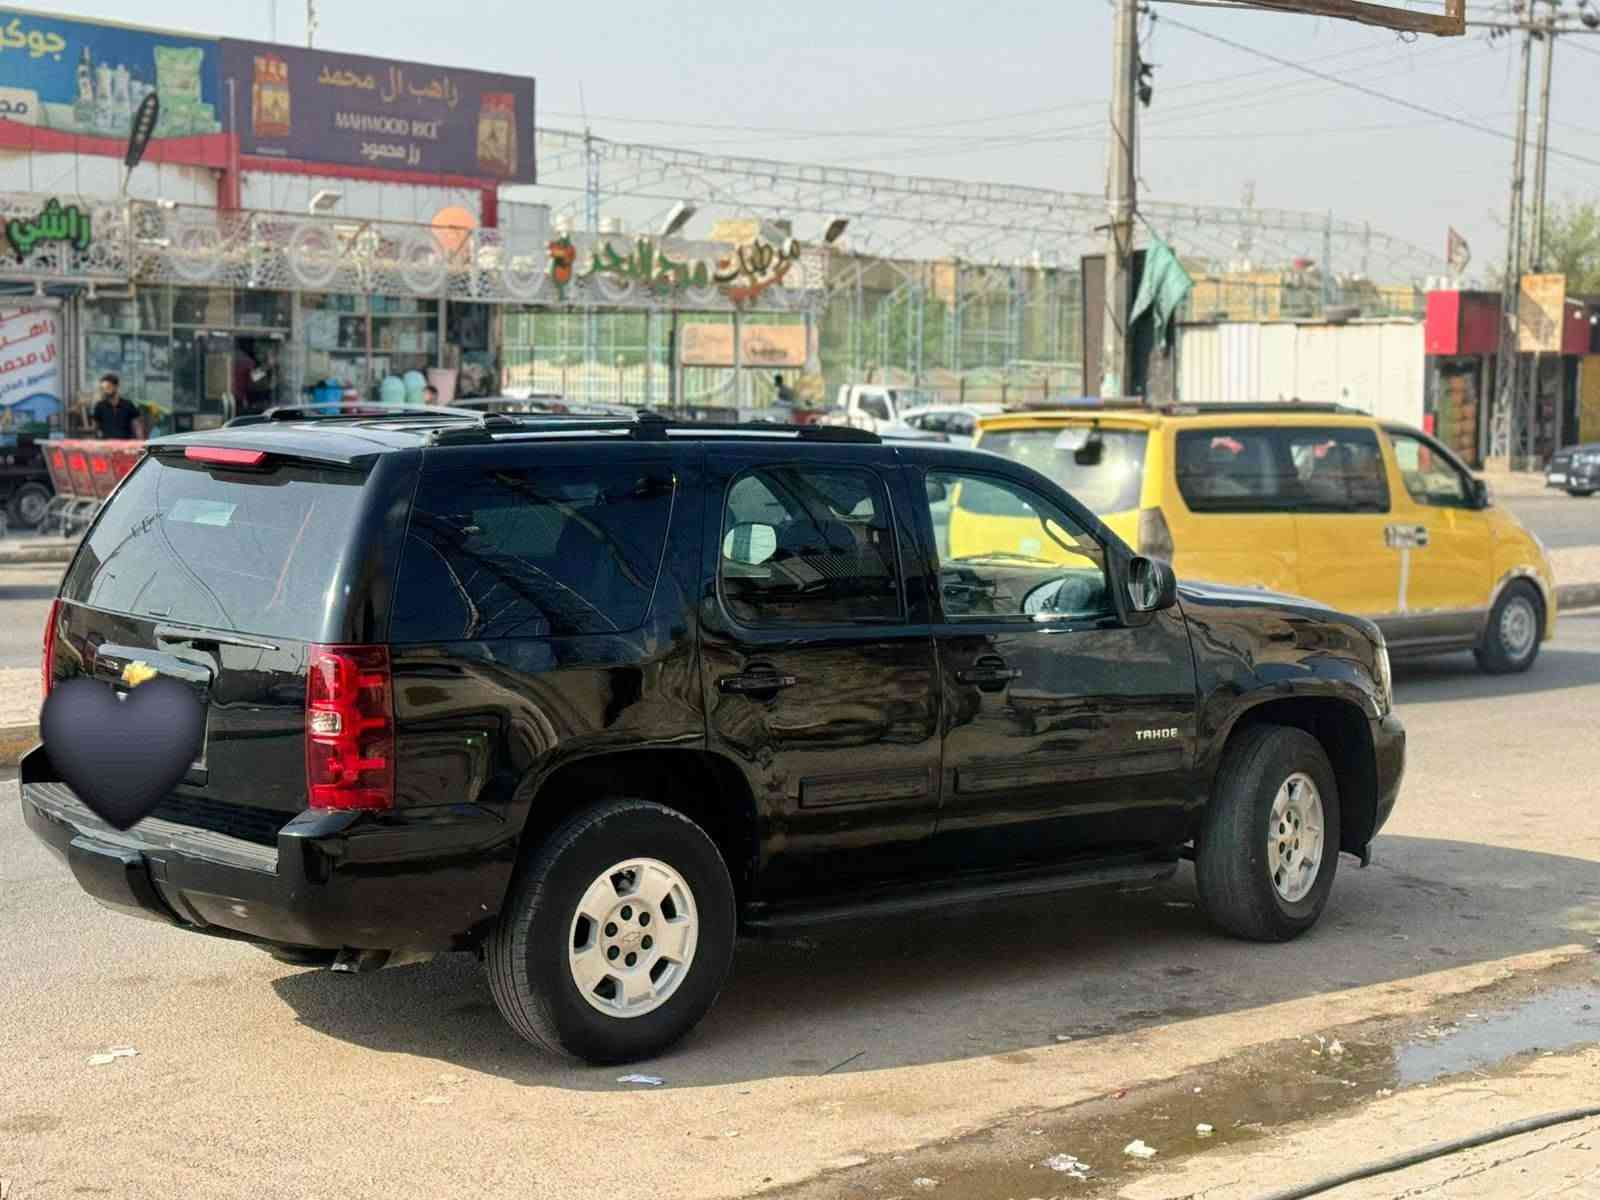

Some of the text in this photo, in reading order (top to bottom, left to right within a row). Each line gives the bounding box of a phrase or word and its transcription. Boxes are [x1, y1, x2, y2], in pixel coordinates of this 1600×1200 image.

[0, 18, 66, 62] جوك
[317, 65, 376, 90] محمد
[408, 74, 459, 110] راهب
[359, 141, 406, 160] محمود
[1136, 727, 1178, 741] TAHOE
